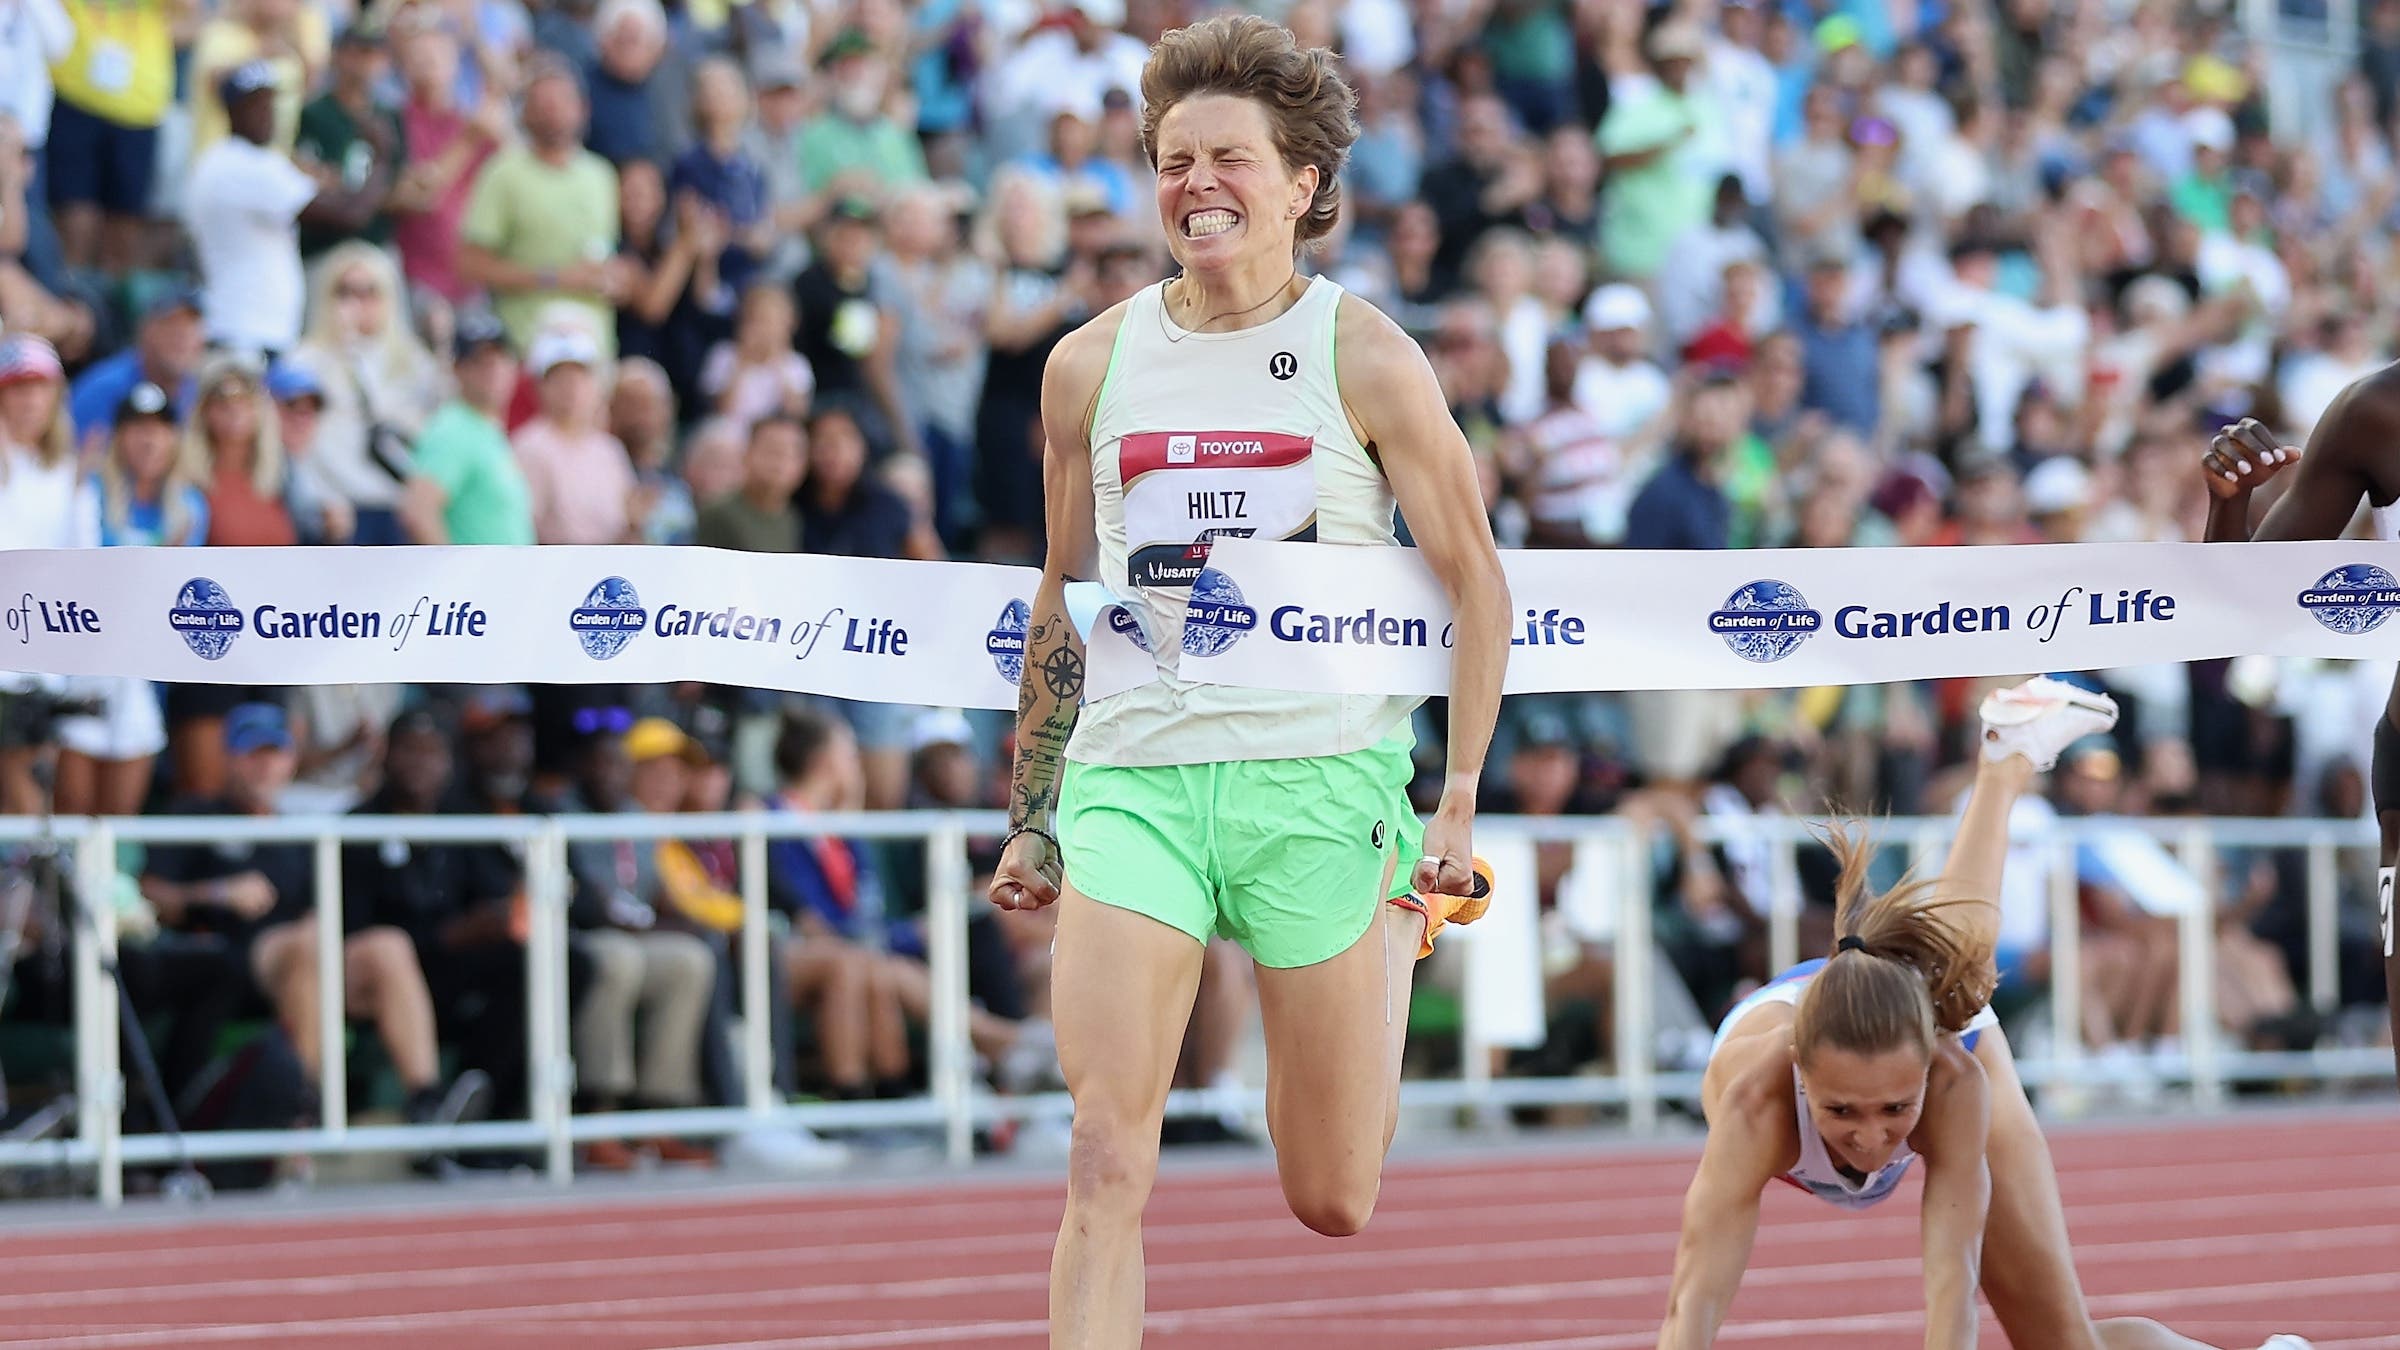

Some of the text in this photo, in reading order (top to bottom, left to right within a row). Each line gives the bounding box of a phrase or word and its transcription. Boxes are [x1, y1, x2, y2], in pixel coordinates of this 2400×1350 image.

[1200, 441, 1264, 455] TOYOTA
[1187, 491, 1247, 519] HILTZ
[2303, 591, 2400, 605] Garden of Life
[7, 593, 101, 644] of Life
[171, 613, 207, 625] Garden
[219, 614, 240, 626] Life
[253, 596, 487, 651] Garden of Life
[573, 611, 643, 629] Garden of Life
[1206, 606, 1224, 625] of
[1223, 610, 1251, 624] Life
[1713, 613, 1815, 631] Garden of Life
[1834, 586, 2176, 643] Garden of Life
[654, 604, 908, 660] Garden of Life
[1270, 605, 1427, 647] Garden
[988, 635, 1022, 649] Garden
